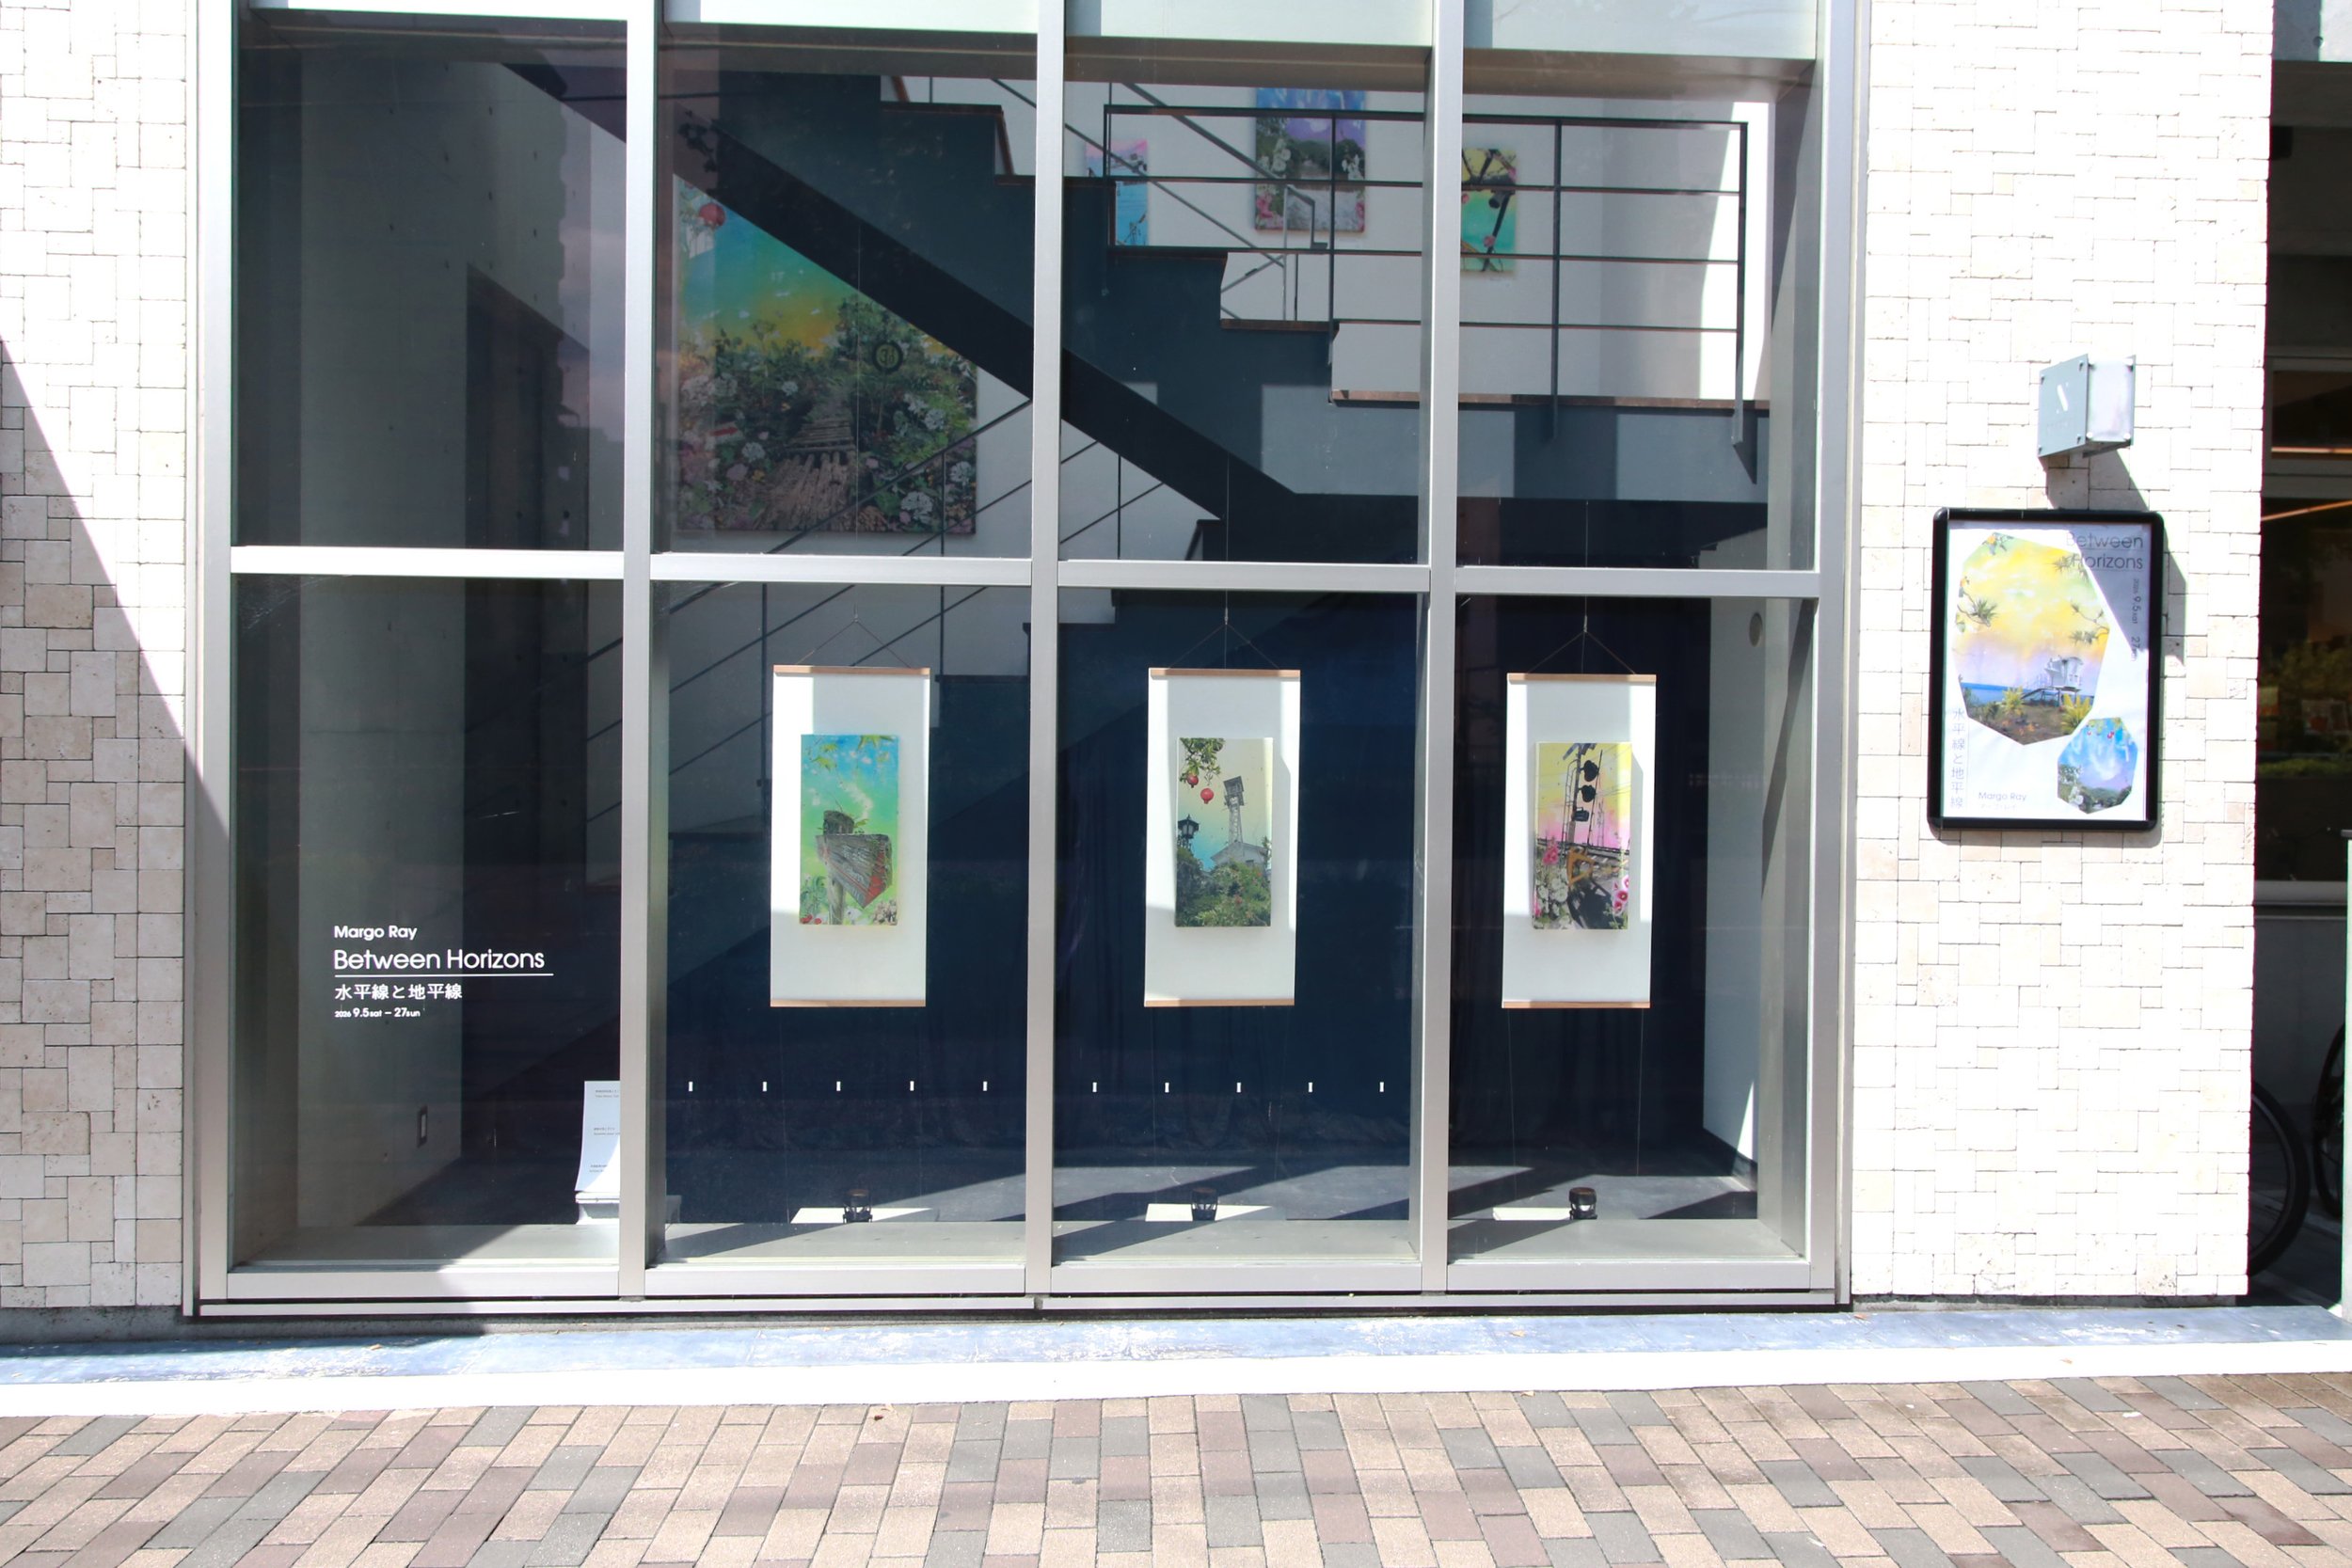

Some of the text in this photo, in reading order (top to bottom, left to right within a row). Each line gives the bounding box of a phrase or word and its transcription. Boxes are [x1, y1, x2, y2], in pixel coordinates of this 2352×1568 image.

[2065, 531, 2144, 548] Between
[2073, 552, 2144, 570] Horizons
[1949, 707, 1965, 809] 水平線と地平線
[1978, 791, 2027, 801] Margo Ray
[334, 925, 418, 941] Margo Ray
[334, 948, 545, 970] Between Horizons
[334, 984, 463, 1001] 水平線と地平線
